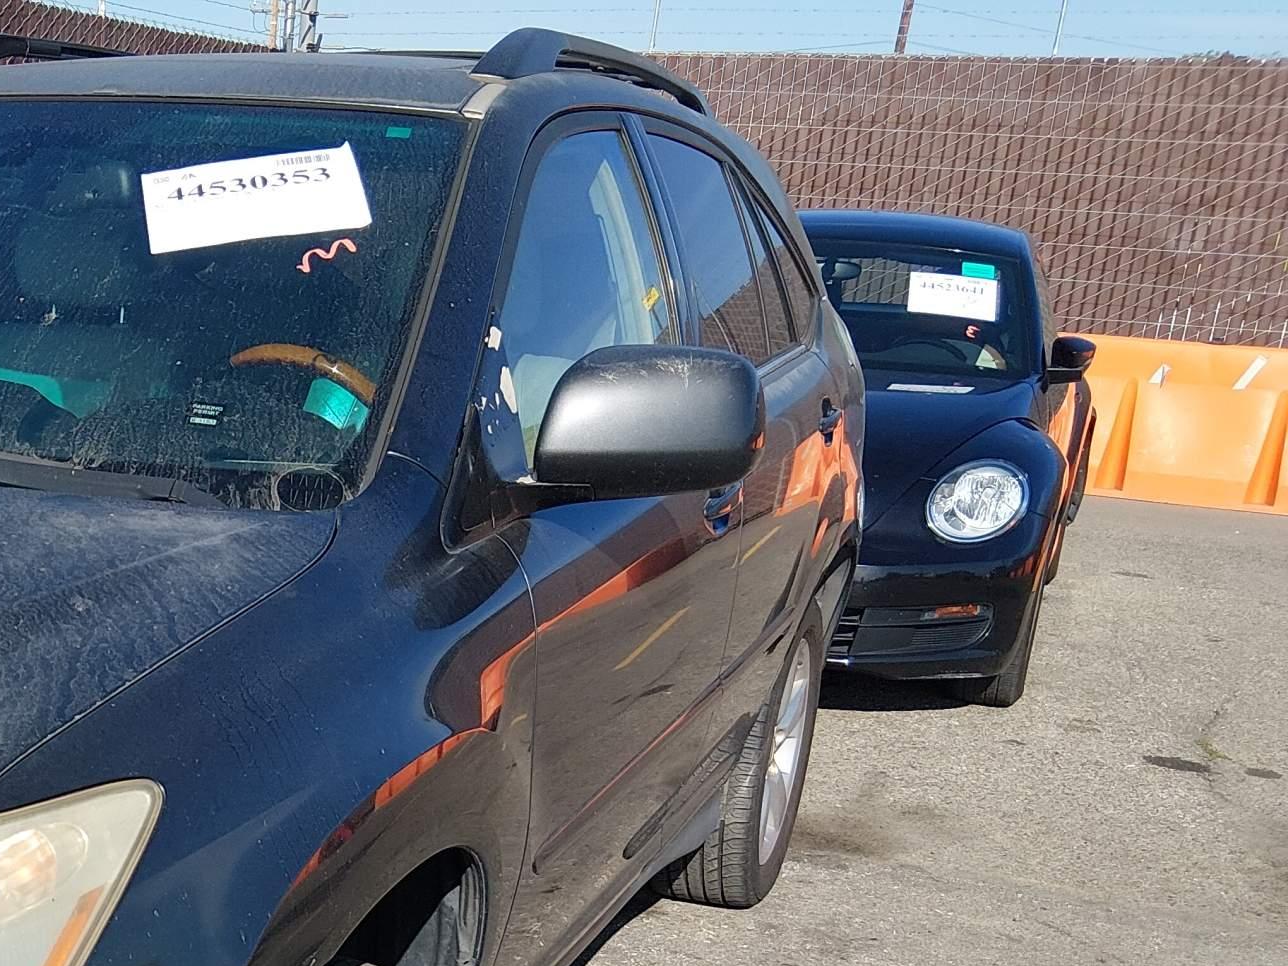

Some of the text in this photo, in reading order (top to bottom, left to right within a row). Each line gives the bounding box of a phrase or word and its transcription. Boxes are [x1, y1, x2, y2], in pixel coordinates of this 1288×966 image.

[167, 167, 331, 201] 44530353
[192, 403, 224, 412] PARKING
[192, 408, 221, 416] PERMIT
